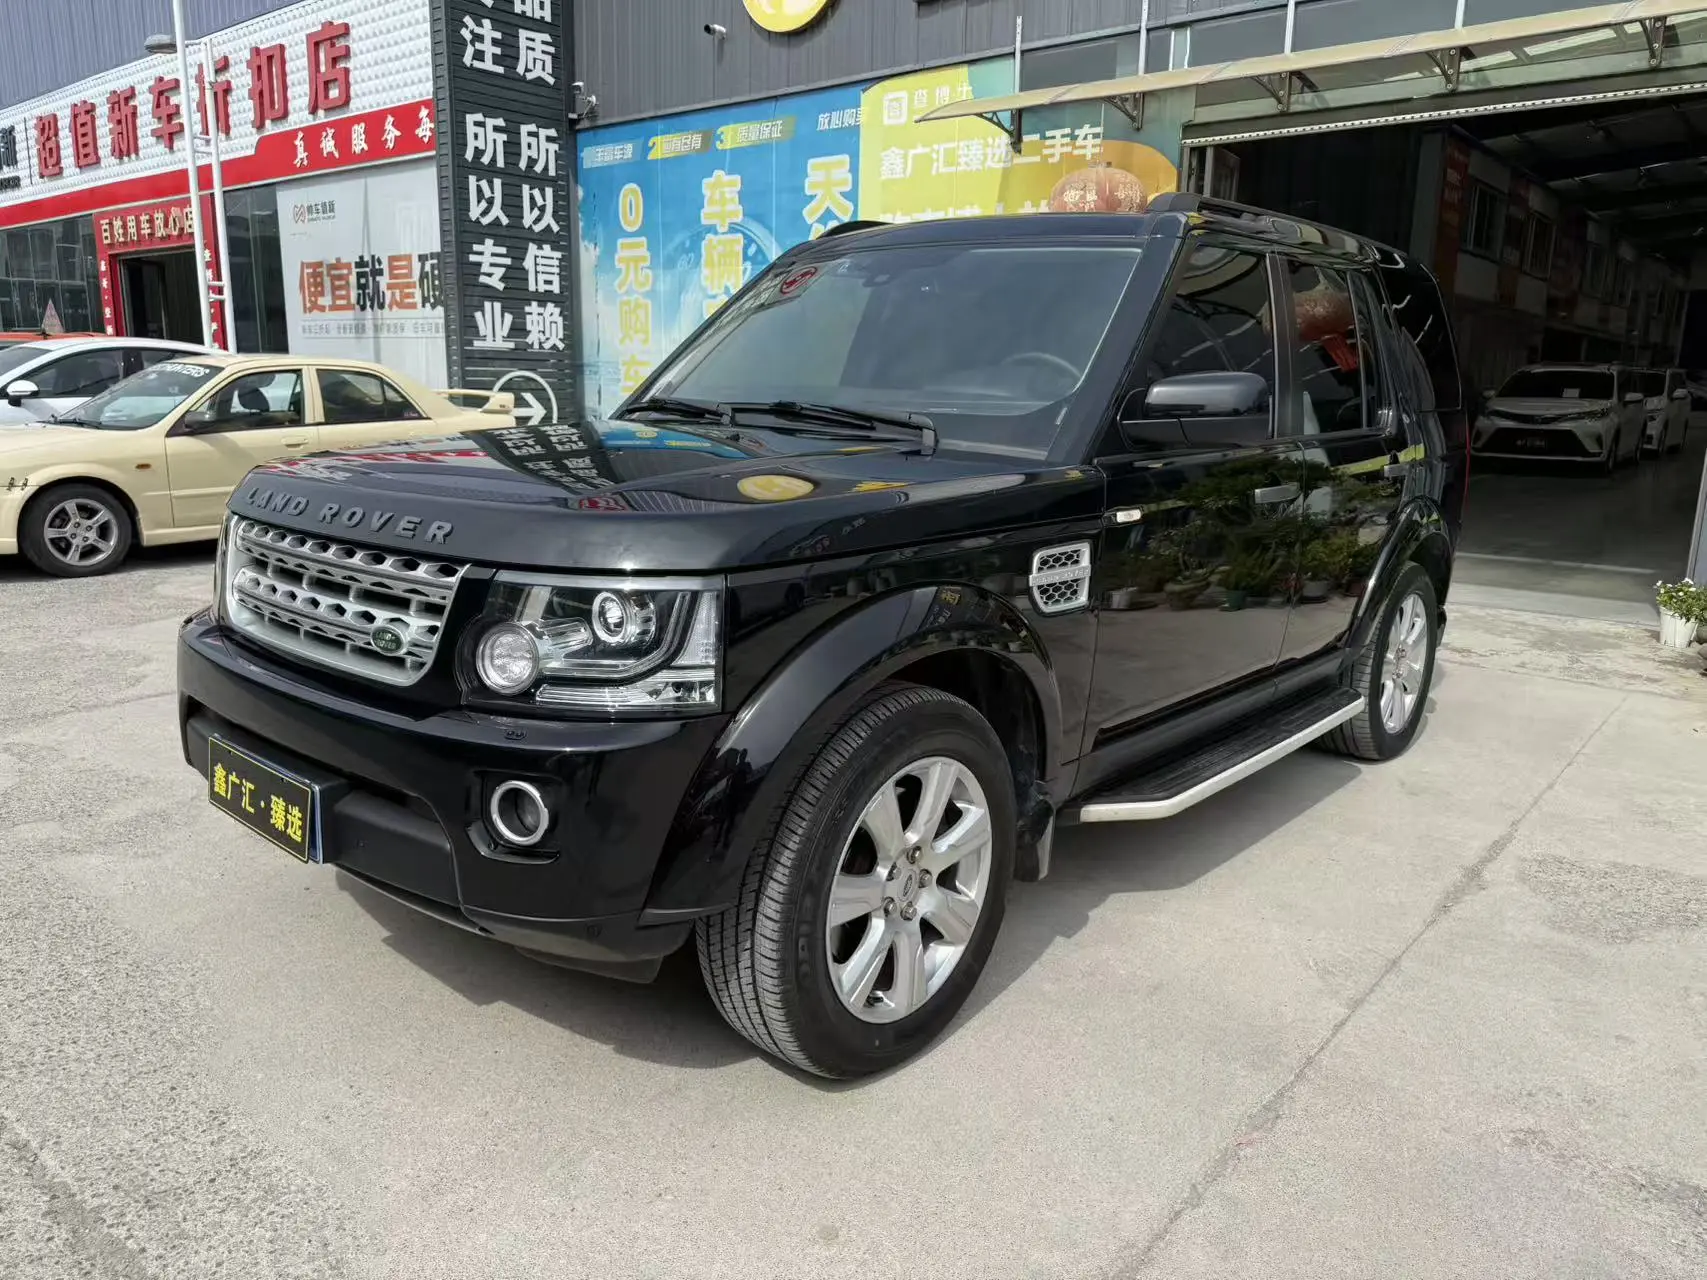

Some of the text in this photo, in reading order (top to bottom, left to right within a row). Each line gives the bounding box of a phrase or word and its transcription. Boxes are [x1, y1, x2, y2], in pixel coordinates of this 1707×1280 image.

[35, 21, 351, 179] 超值新车折扣店
[293, 105, 435, 168] 真诚服务每
[738, 121, 782, 144] 质量保证
[460, 0, 515, 348] 注 所以专业
[880, 124, 1103, 180] 鑫广汇臻选二手车
[100, 204, 194, 245] 百姓用车放心店
[519, 123, 565, 350] 所以信赖
[802, 154, 854, 240] 天
[701, 169, 744, 318] 车辆
[615, 183, 652, 395] 0元购车
[247, 487, 454, 545] LAND ROVER
